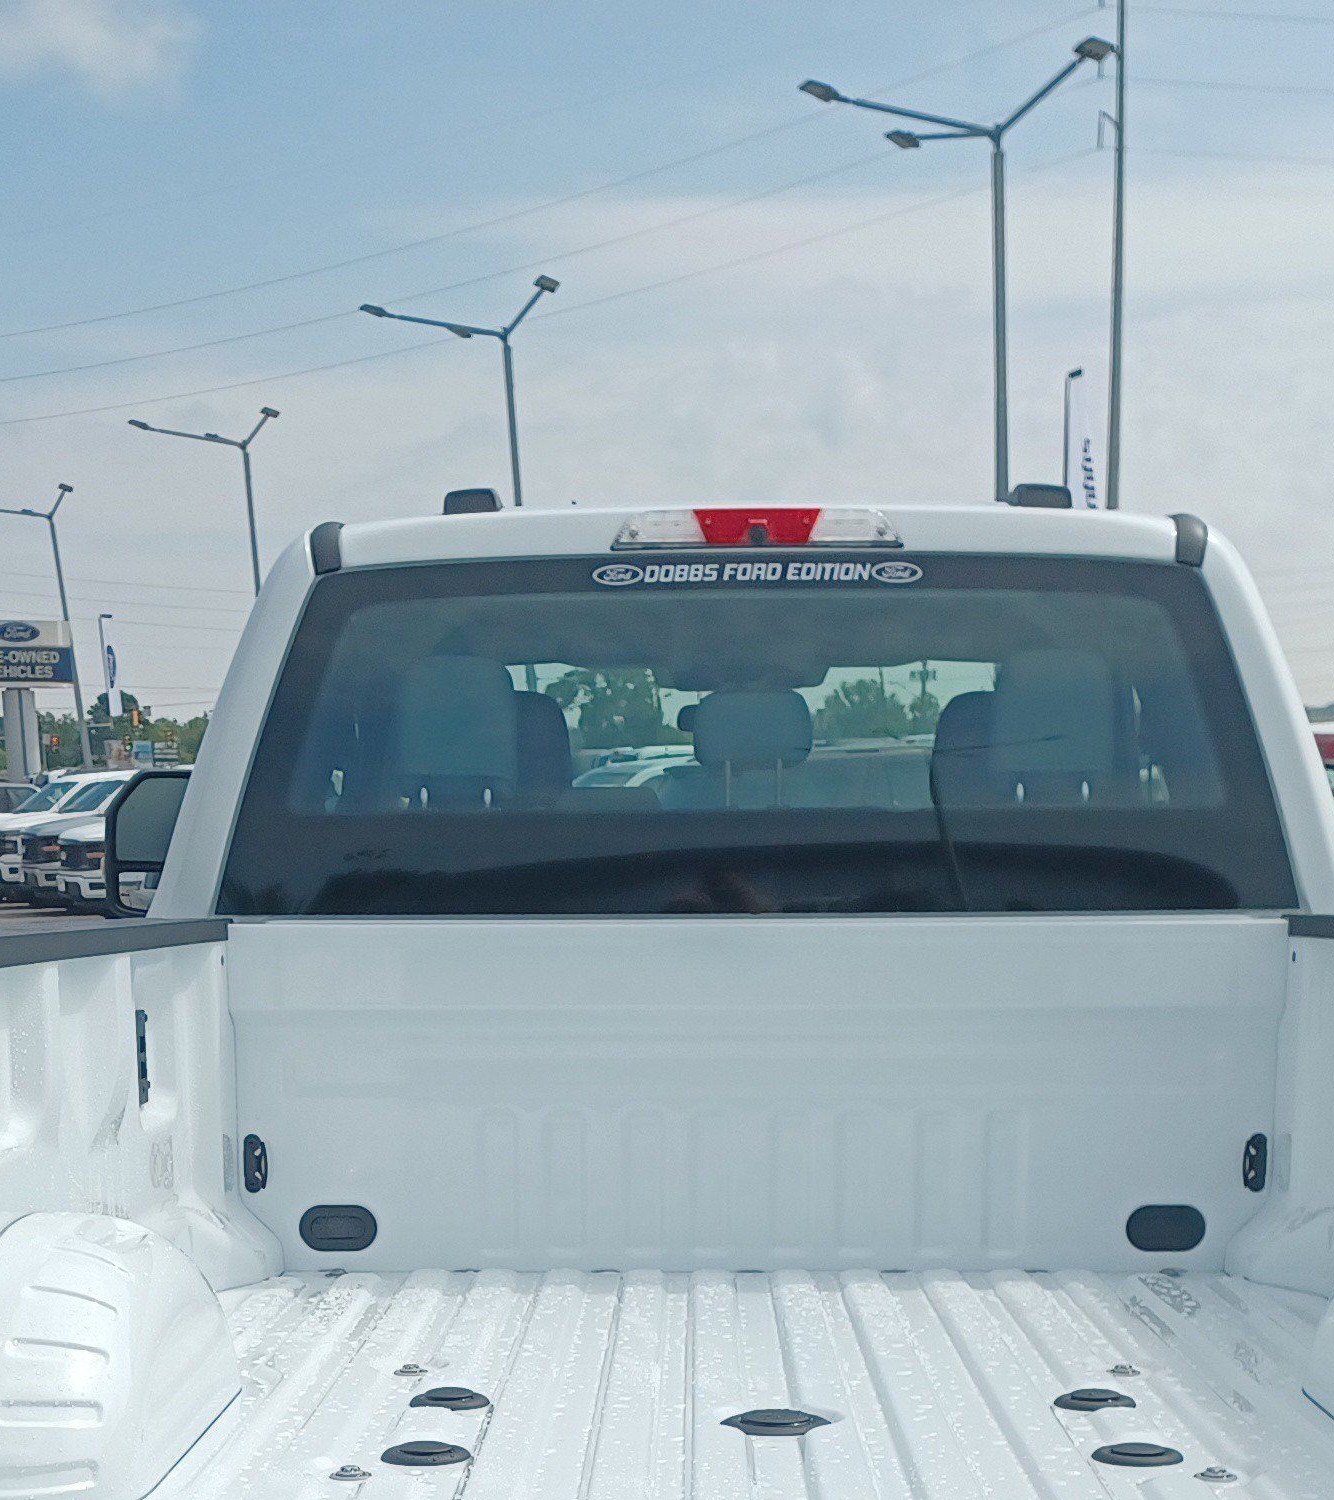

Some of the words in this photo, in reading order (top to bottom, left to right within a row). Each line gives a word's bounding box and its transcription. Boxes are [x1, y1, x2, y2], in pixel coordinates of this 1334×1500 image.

[603, 568, 633, 582] Ford
[643, 564, 718, 583] DOBBS
[722, 563, 782, 581] FORD
[785, 562, 872, 581] EDITION
[882, 565, 913, 579] Ford
